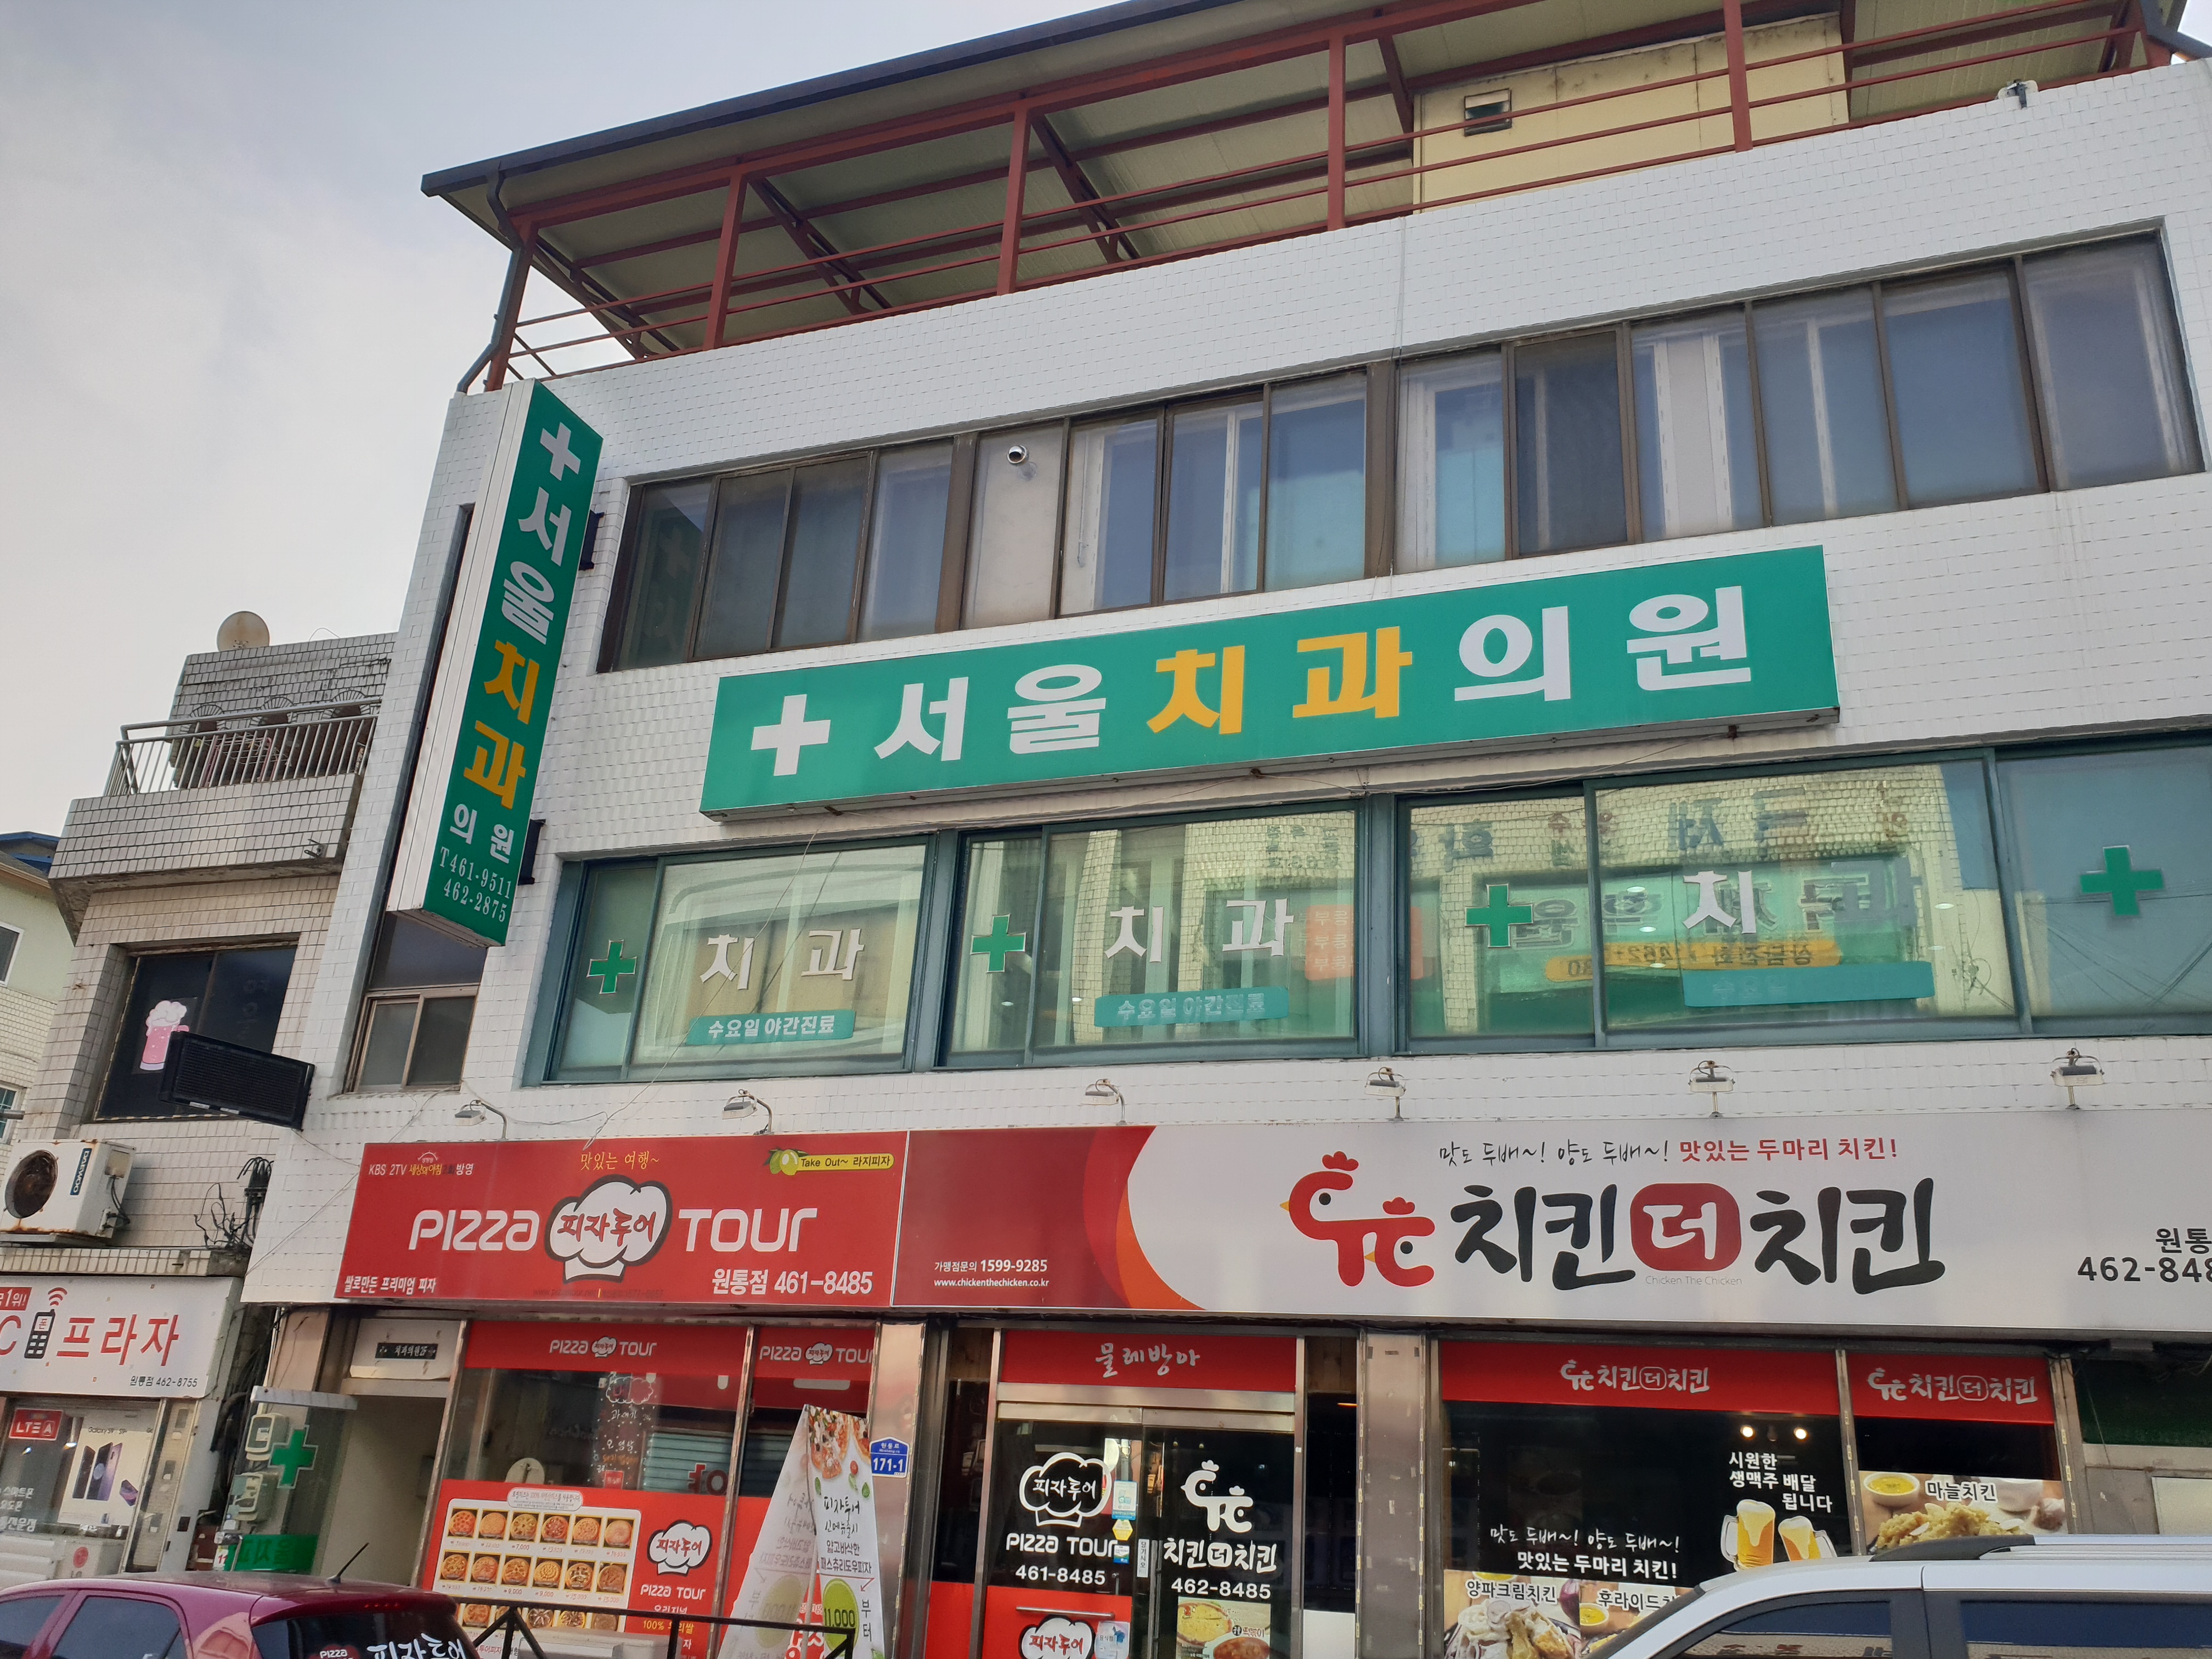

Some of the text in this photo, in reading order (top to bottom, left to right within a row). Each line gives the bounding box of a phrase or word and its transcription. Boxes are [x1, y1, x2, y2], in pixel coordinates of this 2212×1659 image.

[444, 878, 507, 922] 462-2875
[1105, 898, 1294, 962] 치과
[700, 928, 865, 990] 치과
[1118, 997, 1177, 1020] 수요일
[709, 1015, 835, 1038] 수요일 야간진료
[580, 1150, 618, 1171] 맛있는
[801, 1159, 820, 1167] Take
[853, 1155, 890, 1167] 라지피자
[1440, 1144, 1472, 1166] 맛도
[1558, 1143, 1592, 1165] 양도
[1679, 1139, 1750, 1163] 맛있는
[1757, 1138, 1829, 1161] 두마리
[1838, 1137, 1898, 1160] 치킨!
[72, 1149, 90, 1194] DAEWOO
[369, 1164, 386, 1175] KBS
[390, 1164, 407, 1175] 2TV
[456, 1163, 474, 1176] 방영
[557, 1208, 657, 1246] 피자투어
[934, 1260, 1047, 1272] 가맹점문의 1599-9285
[344, 1276, 436, 1295] 쌀로만든 프리미엄 피자
[712, 1268, 873, 1295] 원통점 461-8485
[934, 1278, 1049, 1286] www.chickenthechicken.co.kr
[1646, 1276, 1742, 1285] Chicken The Chicken
[57, 1314, 179, 1366] 프라자
[1096, 1342, 1200, 1377] 물레방아
[156, 1377, 198, 1387] 462-8755
[1729, 1452, 1777, 1471] 시원한
[1033, 1476, 1096, 1500] 피자투어
[1729, 1470, 1816, 1492] 생맥주 배달
[1926, 1481, 1996, 1502] 마늘치킨
[824, 1496, 860, 1521] 피자투어
[1782, 1492, 1833, 1513] 됩니다
[825, 1519, 857, 1538] 신메뉴출시
[1491, 1523, 1517, 1544] 맛도
[1588, 1531, 1617, 1550] 양도
[656, 1538, 702, 1557] 피자투어
[827, 1540, 860, 1556] 얇고바삭한
[1015, 1565, 1105, 1585] 461-8485
[1517, 1550, 1677, 1579] 맛있는 두마리 치킨!
[1172, 1578, 1271, 1600] 462-8485
[1468, 1581, 1556, 1603] 양파크림치킨
[644, 1620, 664, 1630] 100%
[1029, 1634, 1084, 1655] 피자투어
